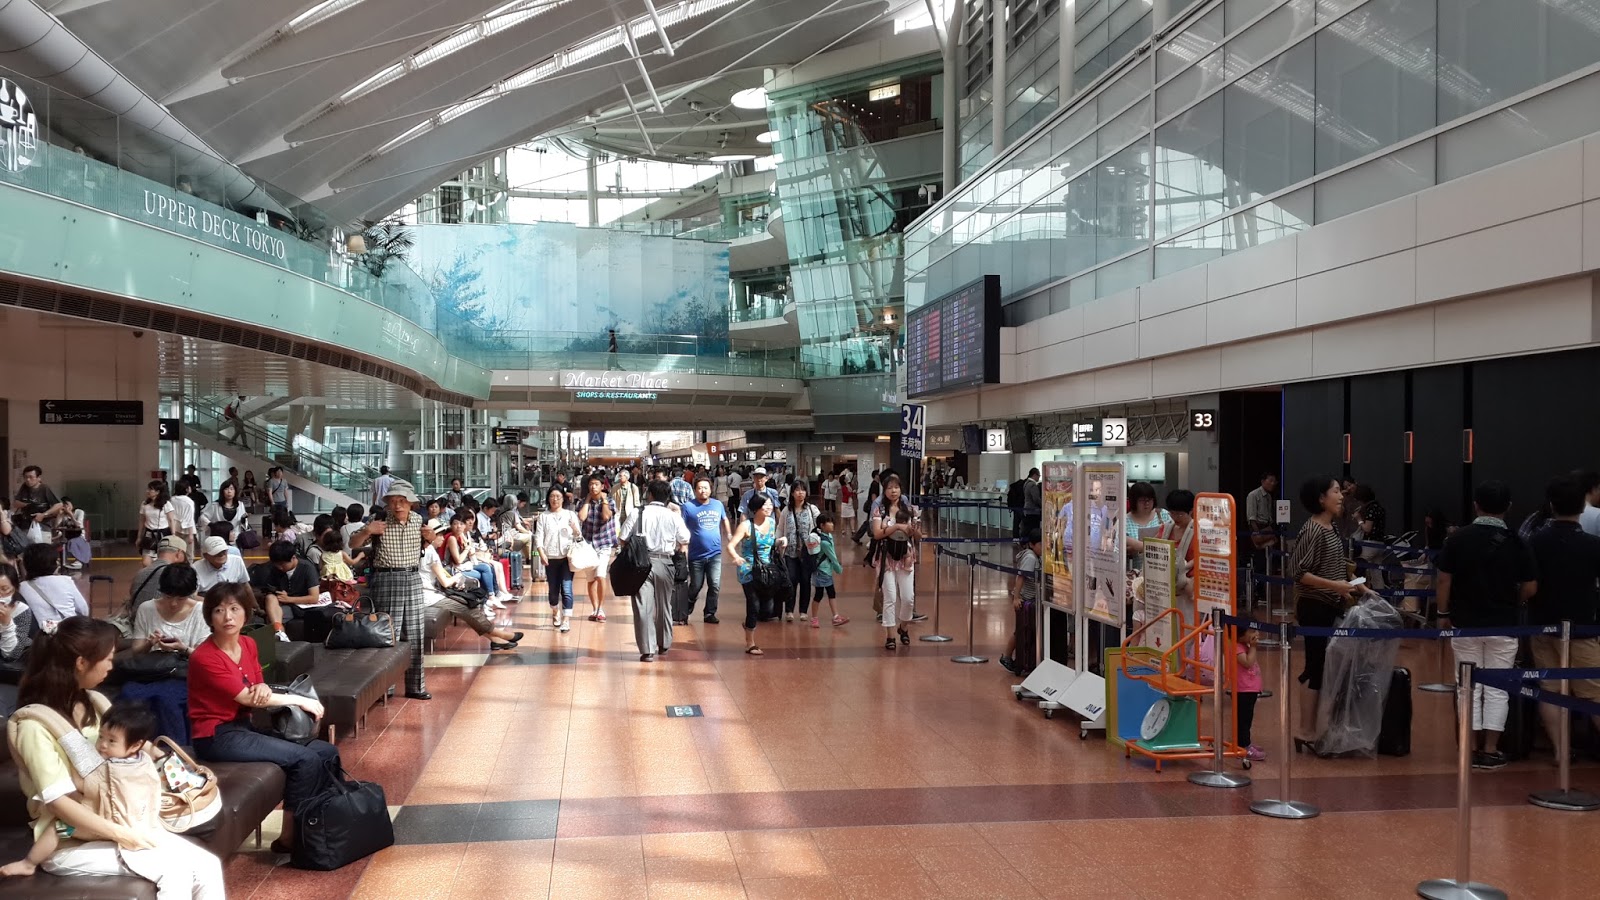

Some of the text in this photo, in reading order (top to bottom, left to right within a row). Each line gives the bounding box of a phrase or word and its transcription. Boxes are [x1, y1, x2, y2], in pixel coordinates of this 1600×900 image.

[144, 190, 285, 259] UPPER DECK TOKYO
[564, 371, 668, 388] Market Place
[606, 392, 658, 400] RESTAURANTS
[901, 405, 923, 437] 34
[1194, 413, 1213, 428] 33
[160, 423, 167, 435] 5
[1104, 424, 1125, 441] 32
[591, 432, 602, 443] A
[901, 436, 921, 450] 手荷物
[989, 433, 1003, 447] 31
[710, 445, 717, 453] B
[901, 449, 921, 459] BAGGAGE
[1522, 670, 1540, 679] ANA
[1520, 686, 1533, 697] ANA
